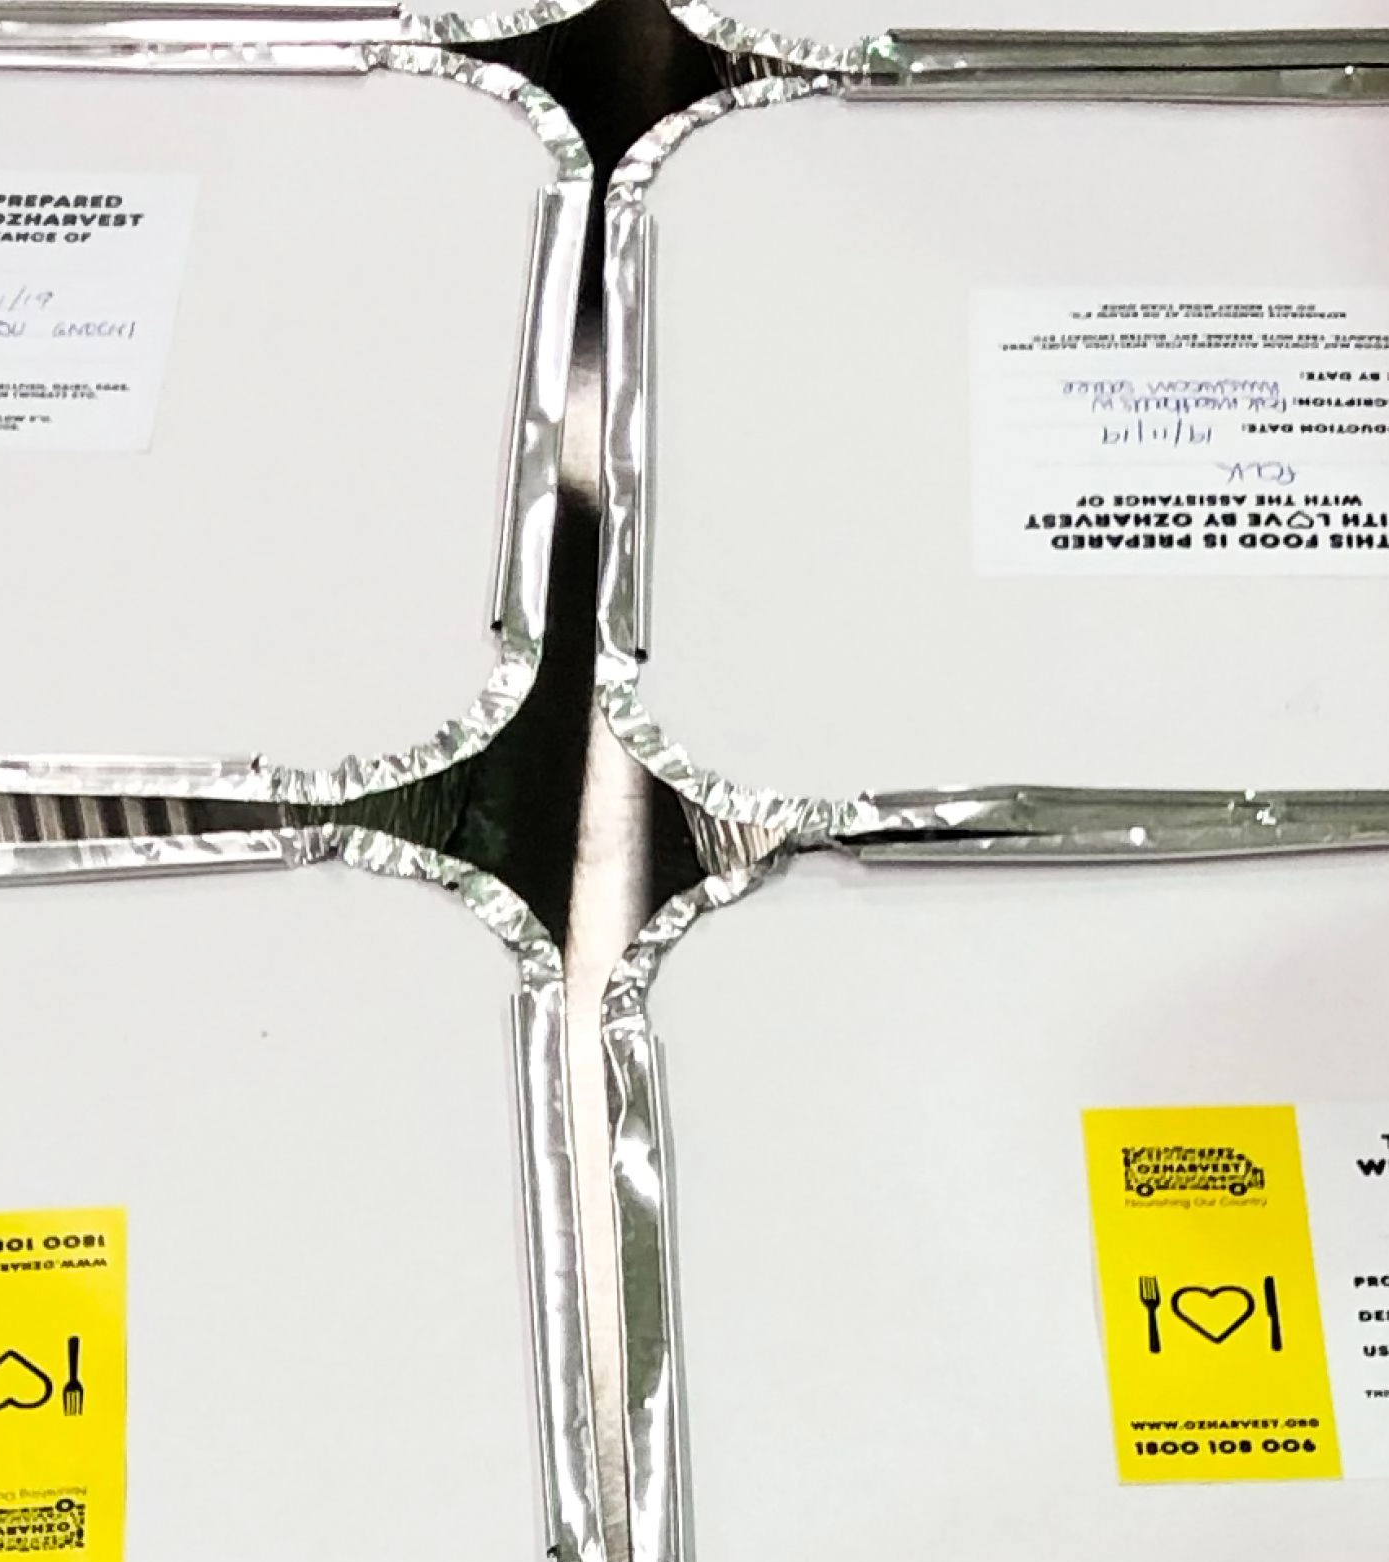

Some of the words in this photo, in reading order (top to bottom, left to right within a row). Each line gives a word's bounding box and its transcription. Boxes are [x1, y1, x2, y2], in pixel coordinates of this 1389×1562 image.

[64, 232, 91, 242] OF
[1243, 424, 1293, 433] DATE:
[1077, 496, 1104, 507] OF
[1114, 495, 1247, 506] ASSISTANCE
[1256, 495, 1294, 506] THE
[1304, 495, 1362, 506] WITH
[1026, 513, 1192, 529] OZHARVEST
[1204, 513, 1237, 527] BY
[1051, 534, 1191, 549] PREPARED
[1203, 533, 1227, 548] IS
[1239, 533, 1318, 548] FOOD
[43, 1235, 104, 1250] 1800
[1135, 1441, 1199, 1455] 1800
[1209, 1440, 1252, 1454] 108
[1262, 1439, 1316, 1453] 006
